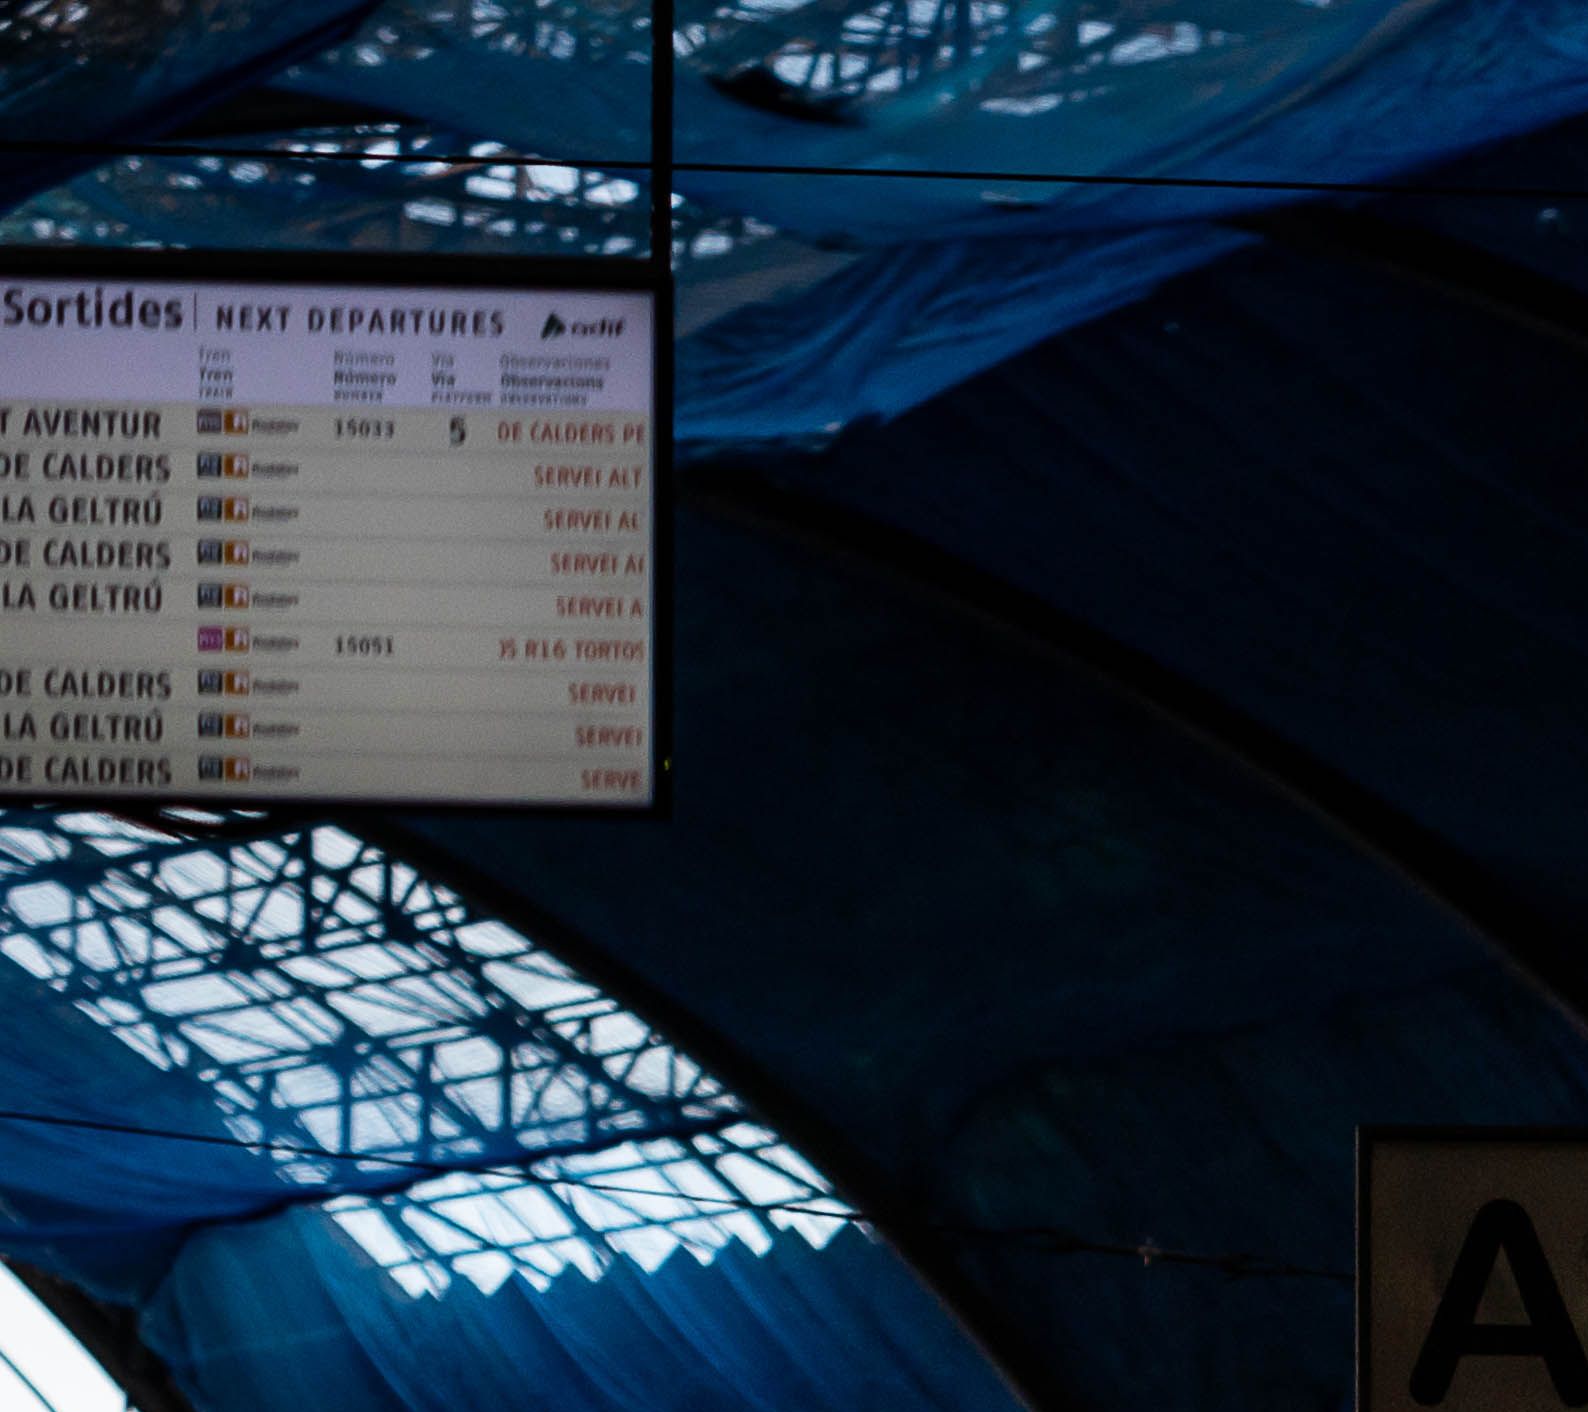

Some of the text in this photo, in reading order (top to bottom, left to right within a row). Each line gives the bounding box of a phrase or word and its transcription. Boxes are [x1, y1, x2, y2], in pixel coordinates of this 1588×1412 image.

[3, 286, 503, 336] Sortides NEXT DEPARTURES
[23, 408, 161, 438] AVENTUR
[530, 421, 615, 443] CALDERS
[43, 453, 170, 483] CALDERS
[3, 496, 35, 522] LA
[49, 490, 161, 526] GELTRÚ
[43, 540, 170, 569] CALDERS
[3, 581, 36, 609] LA
[50, 577, 161, 612] GELTRÚ
[44, 669, 171, 698] CALDERS
[4, 711, 36, 739] LA
[50, 706, 163, 741] GELTRÚ
[44, 755, 171, 784] CALDERS
